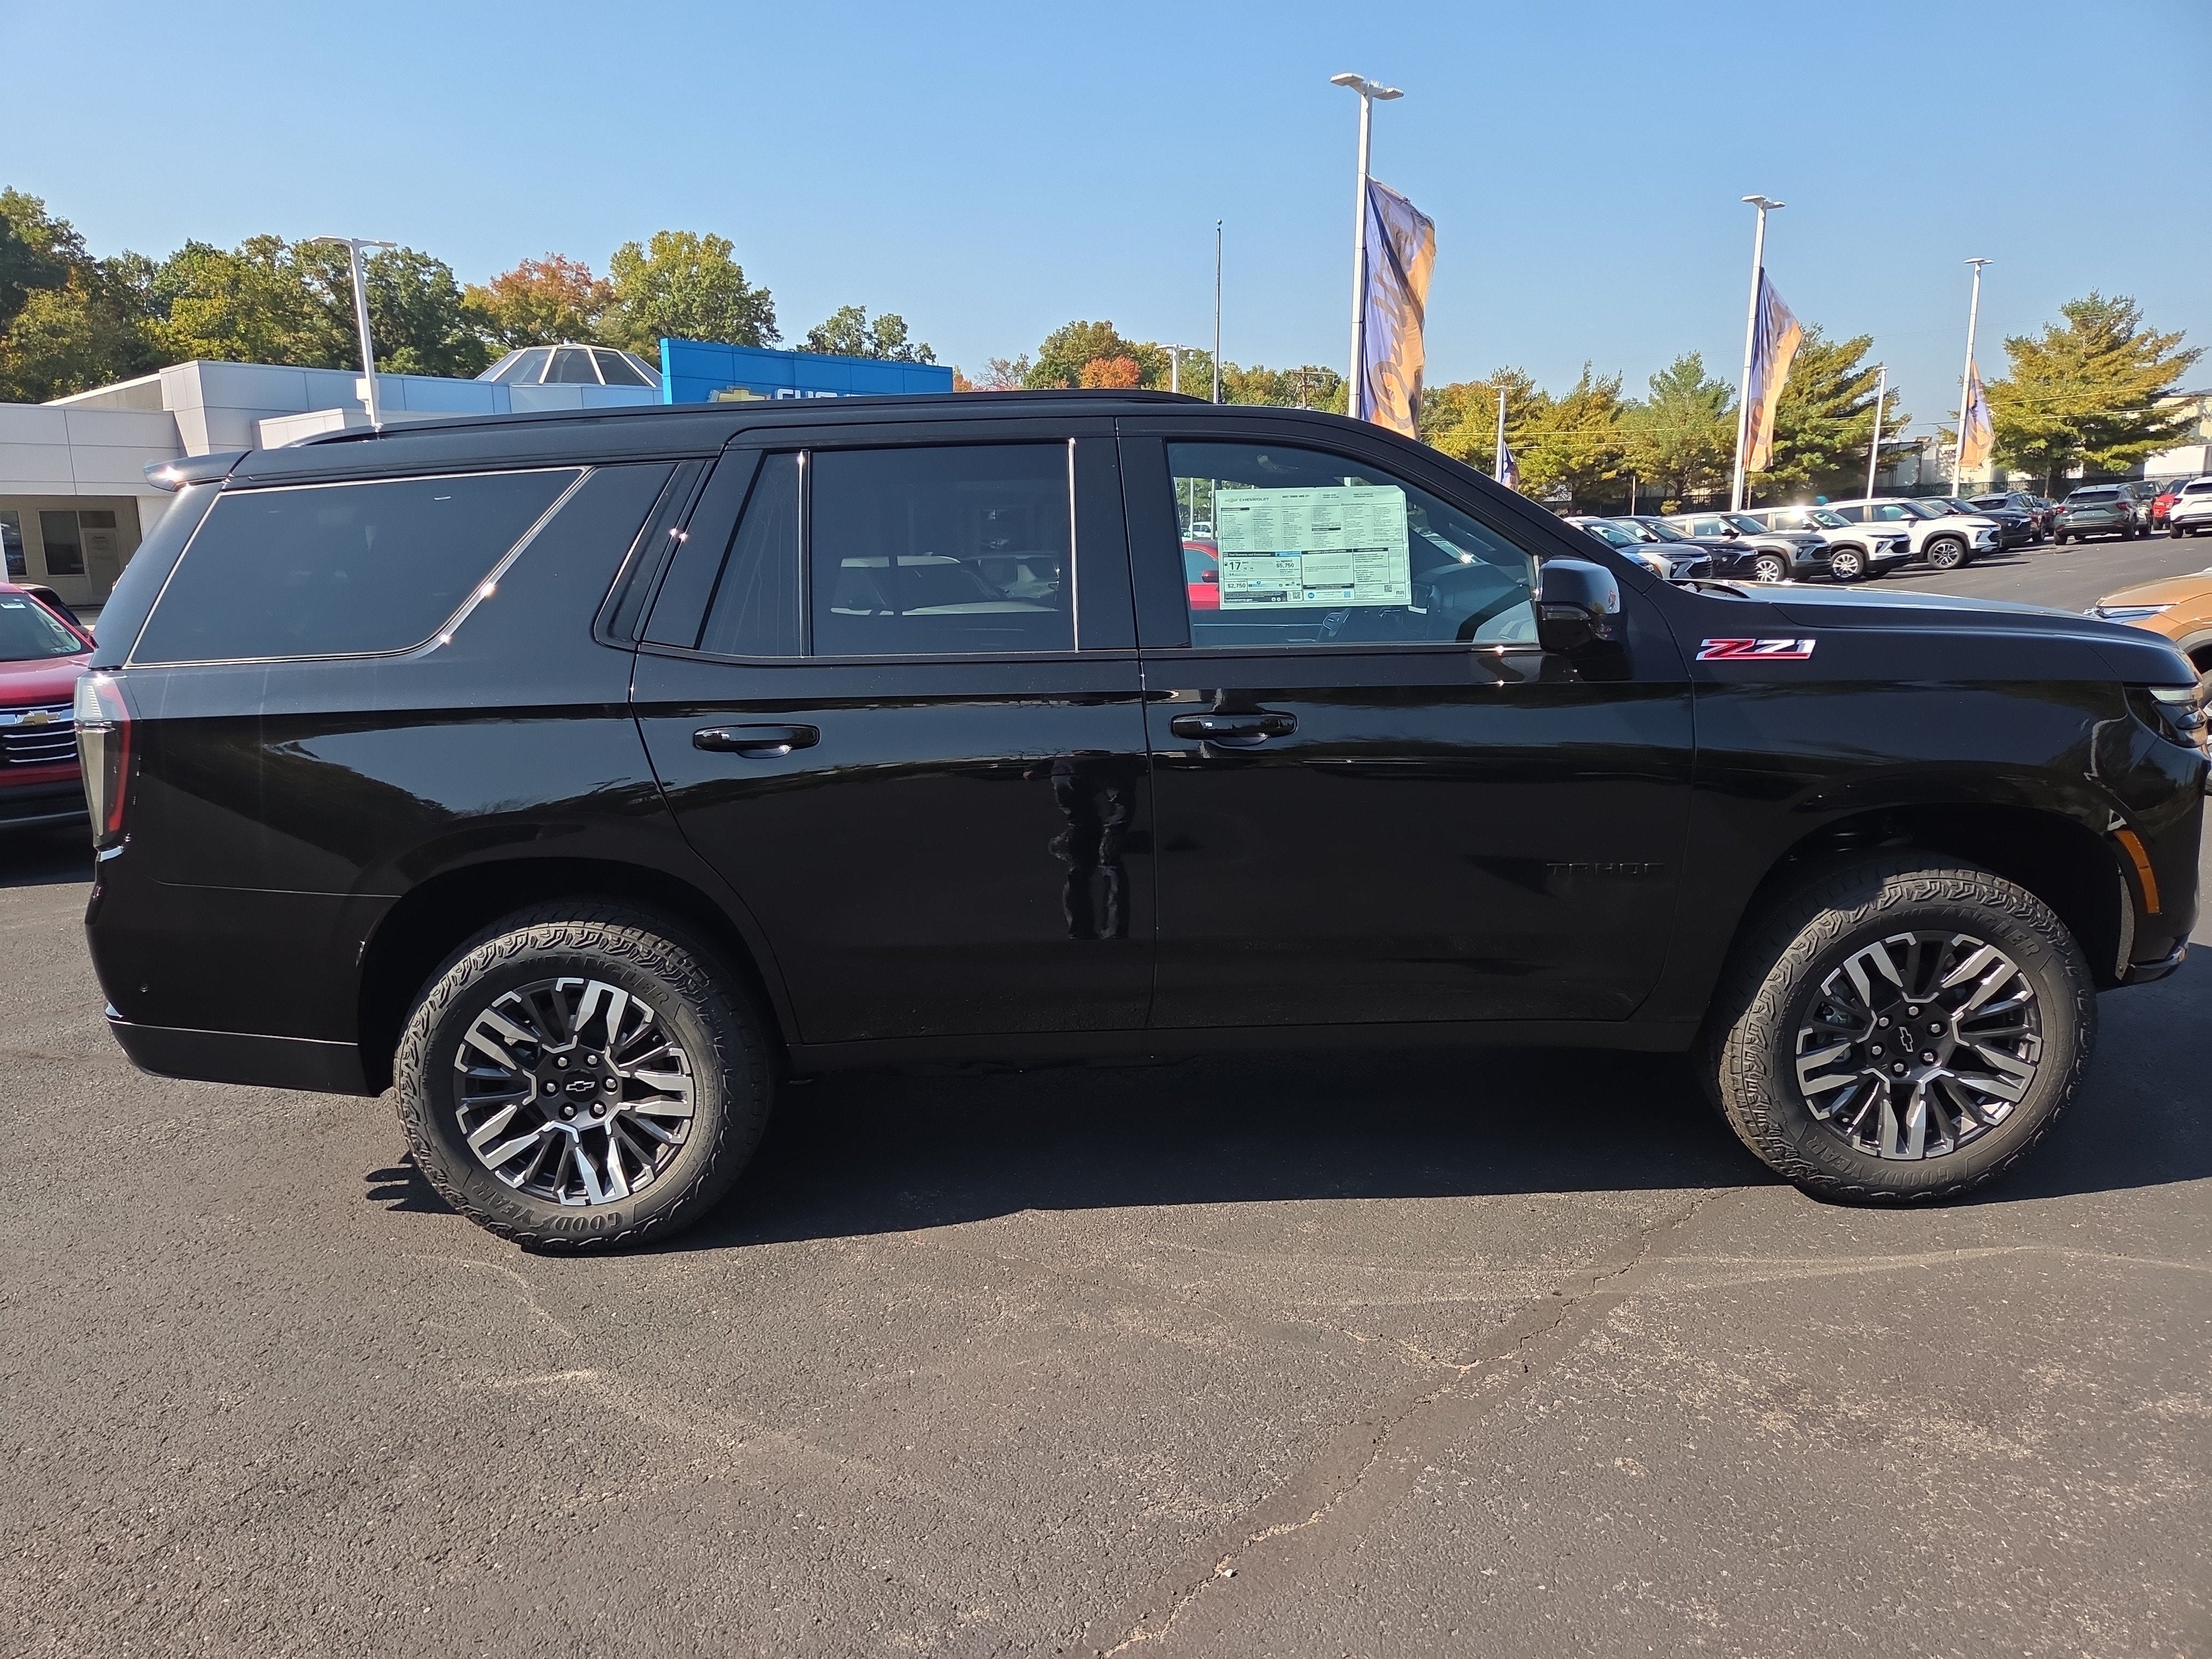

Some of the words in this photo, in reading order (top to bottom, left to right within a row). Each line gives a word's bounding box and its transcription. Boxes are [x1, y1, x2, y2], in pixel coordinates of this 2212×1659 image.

[1229, 562, 1241, 570] 17
[1696, 639, 1816, 660] Z71
[1805, 1136, 1956, 1186] GOODYEAR
[471, 1180, 624, 1232] GOODYEAR
